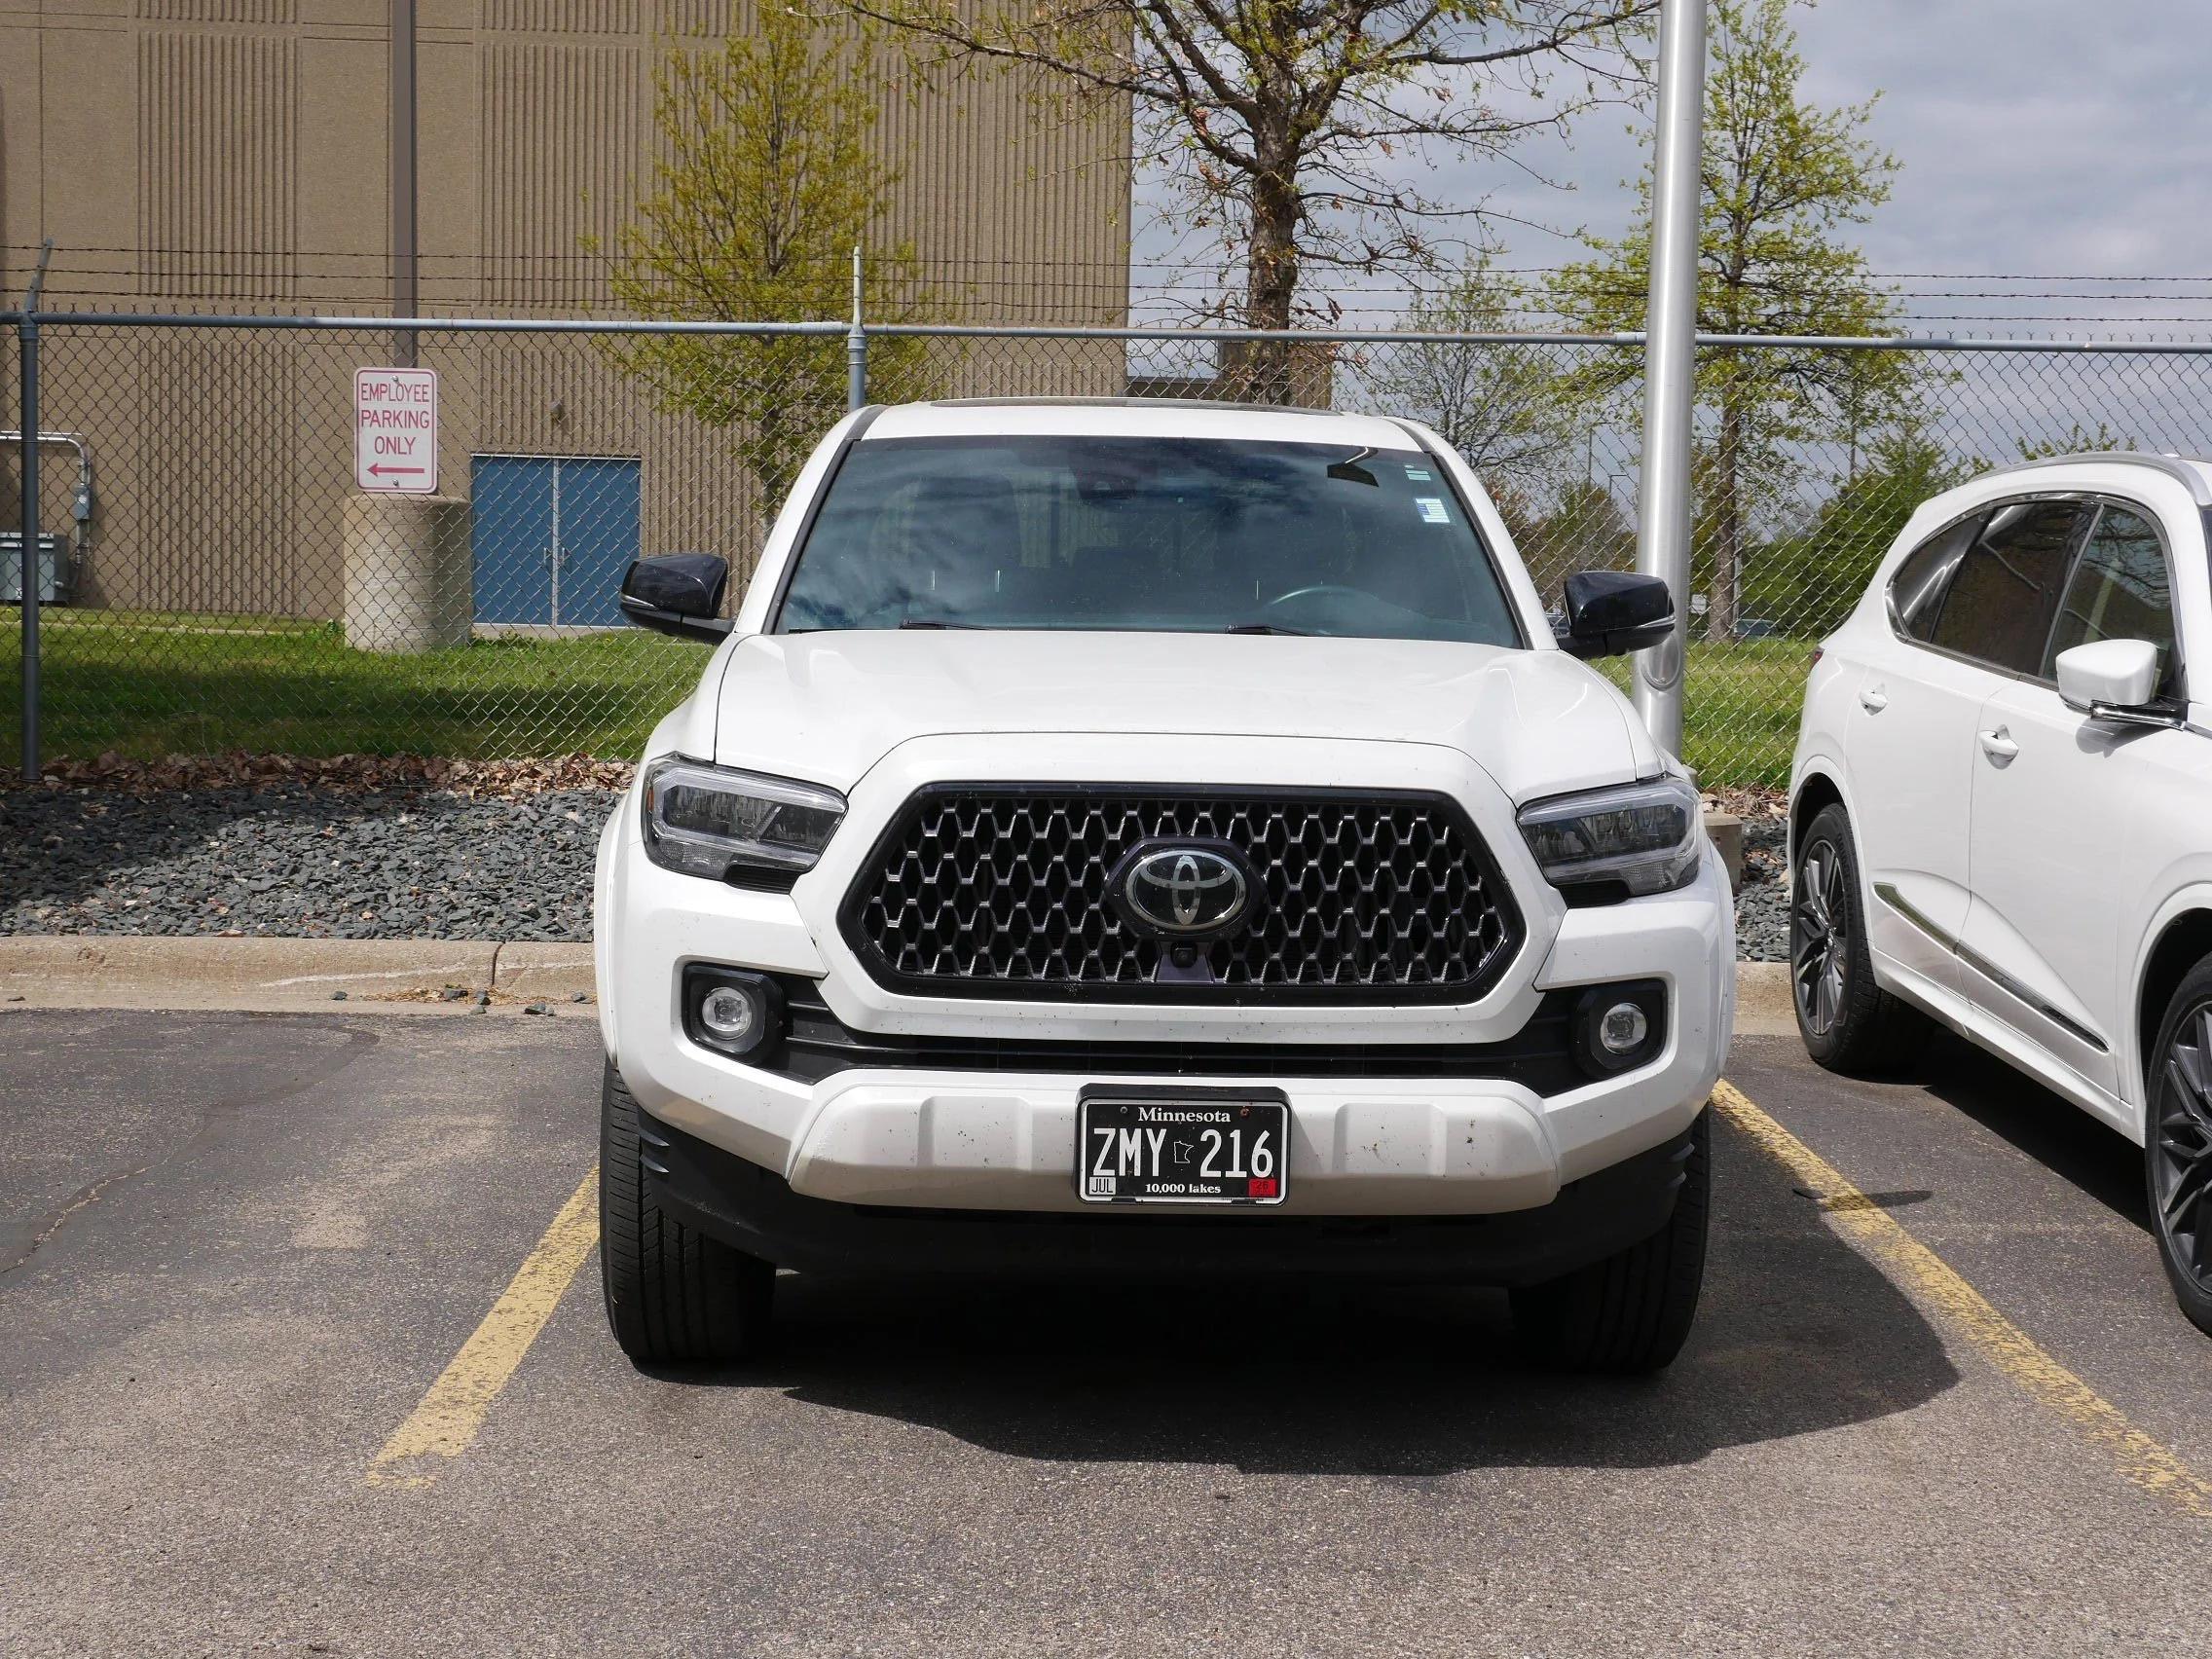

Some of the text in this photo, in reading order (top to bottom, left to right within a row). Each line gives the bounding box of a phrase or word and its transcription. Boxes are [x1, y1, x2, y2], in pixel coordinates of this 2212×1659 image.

[360, 383, 429, 402] EMPLOYEE
[361, 410, 429, 428] PARKING
[374, 436, 417, 455] ONLY
[1138, 1107, 1231, 1123] Minnesota
[1093, 1127, 1273, 1178] ZMY 216
[1092, 1178, 1114, 1194] JUL
[1145, 1183, 1221, 1194] 10,000 lakes
